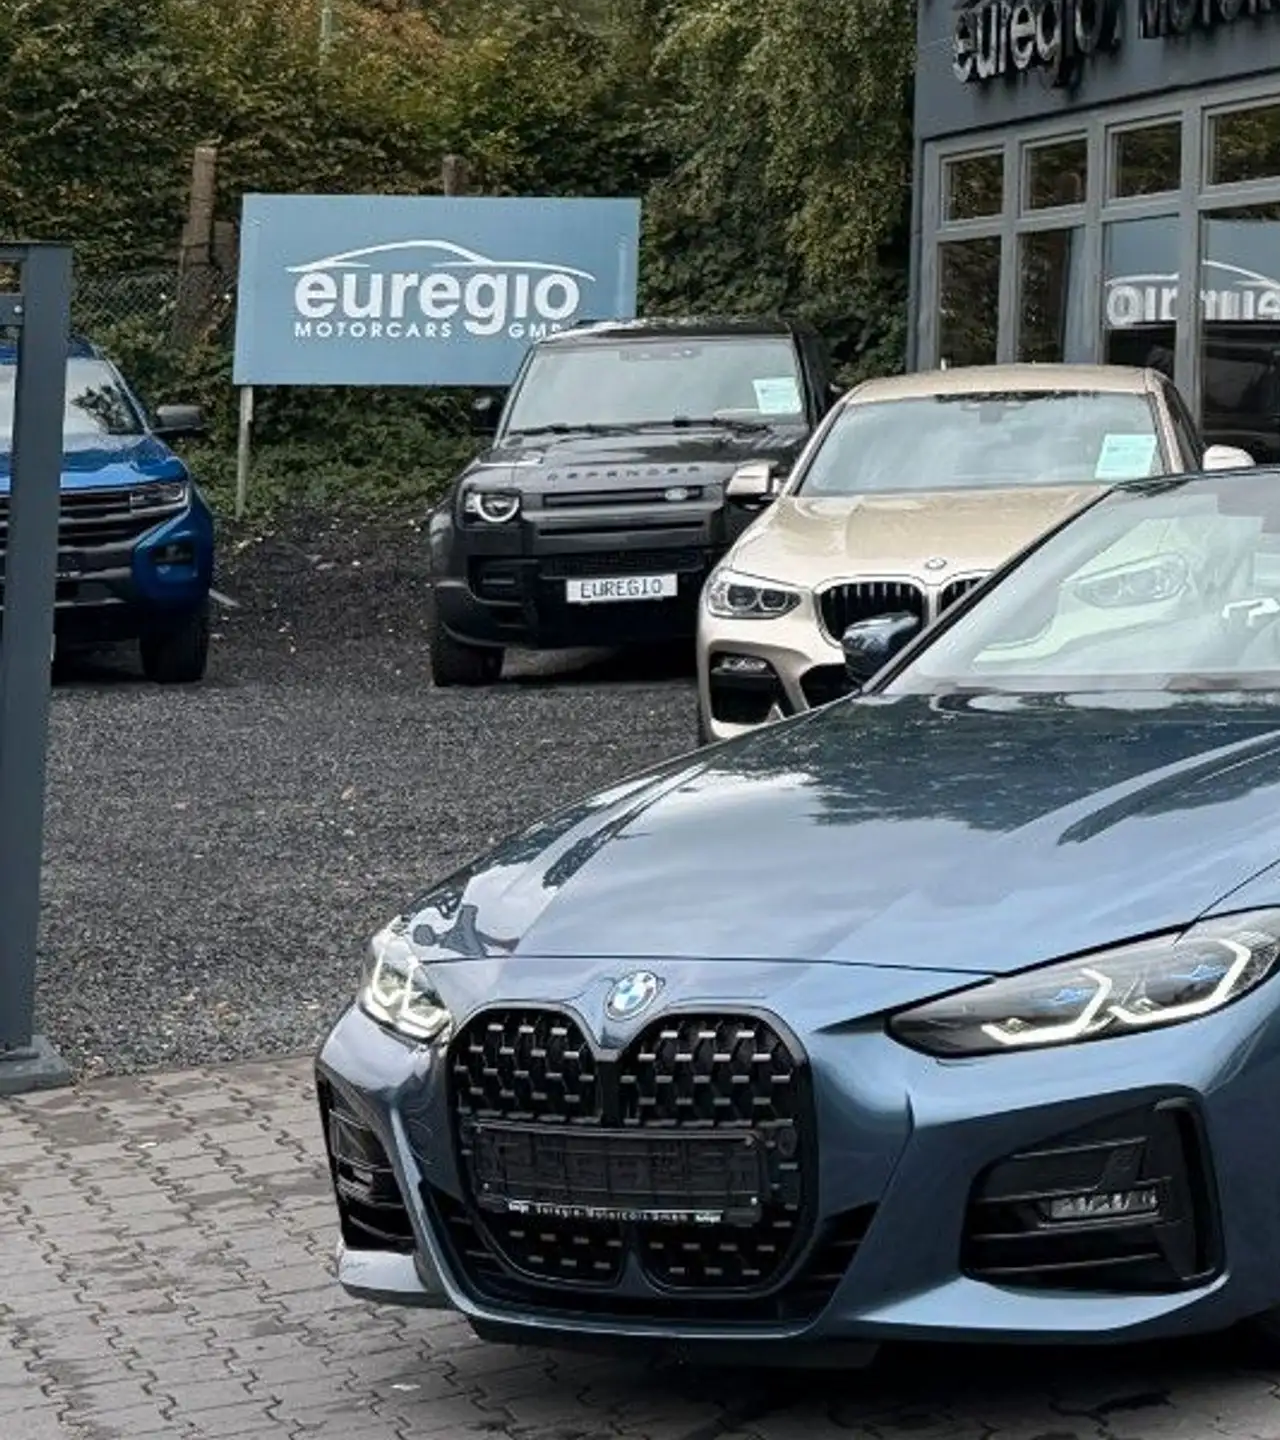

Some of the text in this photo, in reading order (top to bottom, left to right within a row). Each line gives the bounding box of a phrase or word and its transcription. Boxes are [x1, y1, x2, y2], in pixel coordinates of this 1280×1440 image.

[294, 272, 580, 335] euregio
[294, 321, 452, 337] MOTORCARS
[580, 578, 663, 599] EUREGIO
